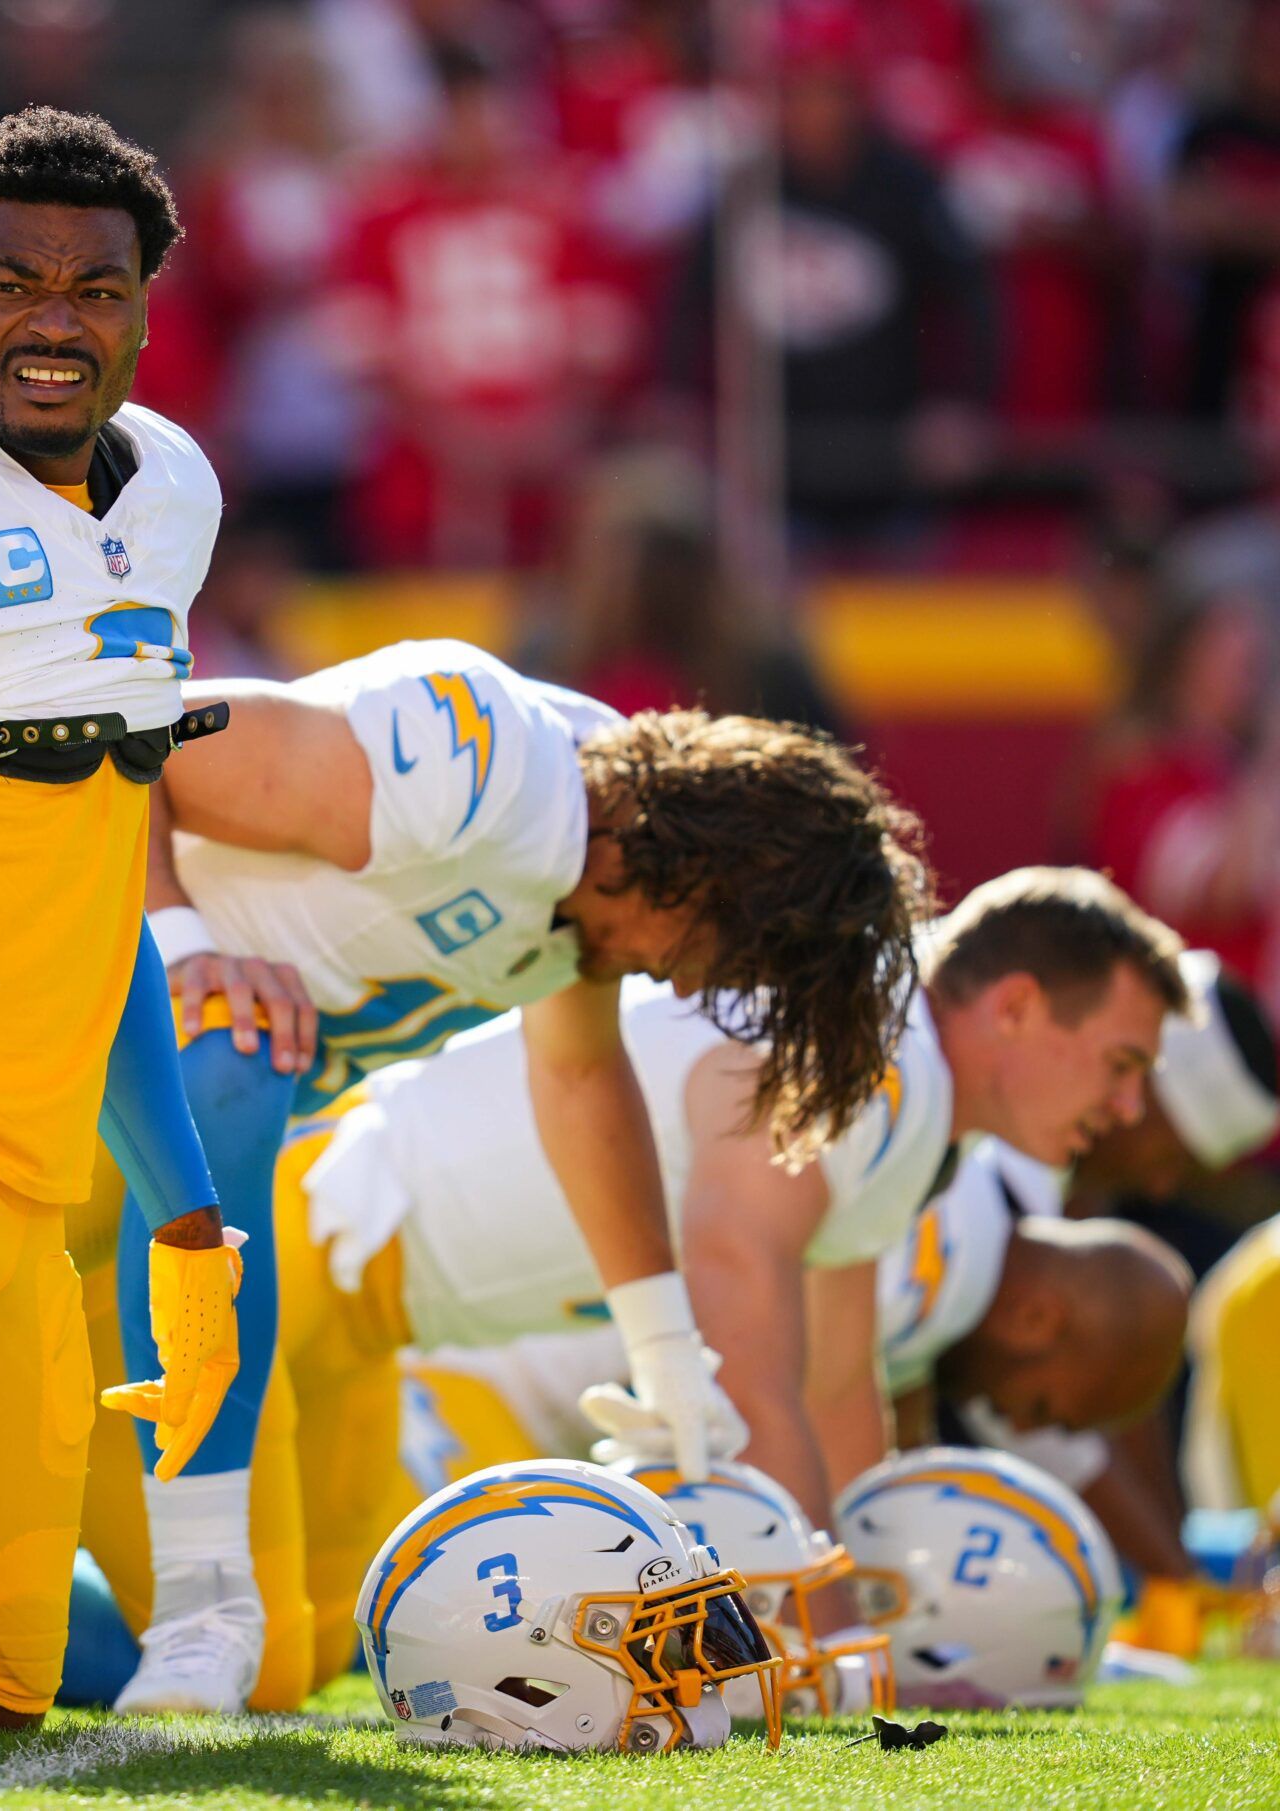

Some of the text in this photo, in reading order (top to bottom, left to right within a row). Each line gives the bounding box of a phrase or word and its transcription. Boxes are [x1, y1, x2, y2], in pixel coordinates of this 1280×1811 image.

[108, 554, 129, 573] NFL
[954, 1525, 1002, 1587] 2
[477, 1553, 523, 1632] 3
[643, 1567, 682, 1588] OAKLEY
